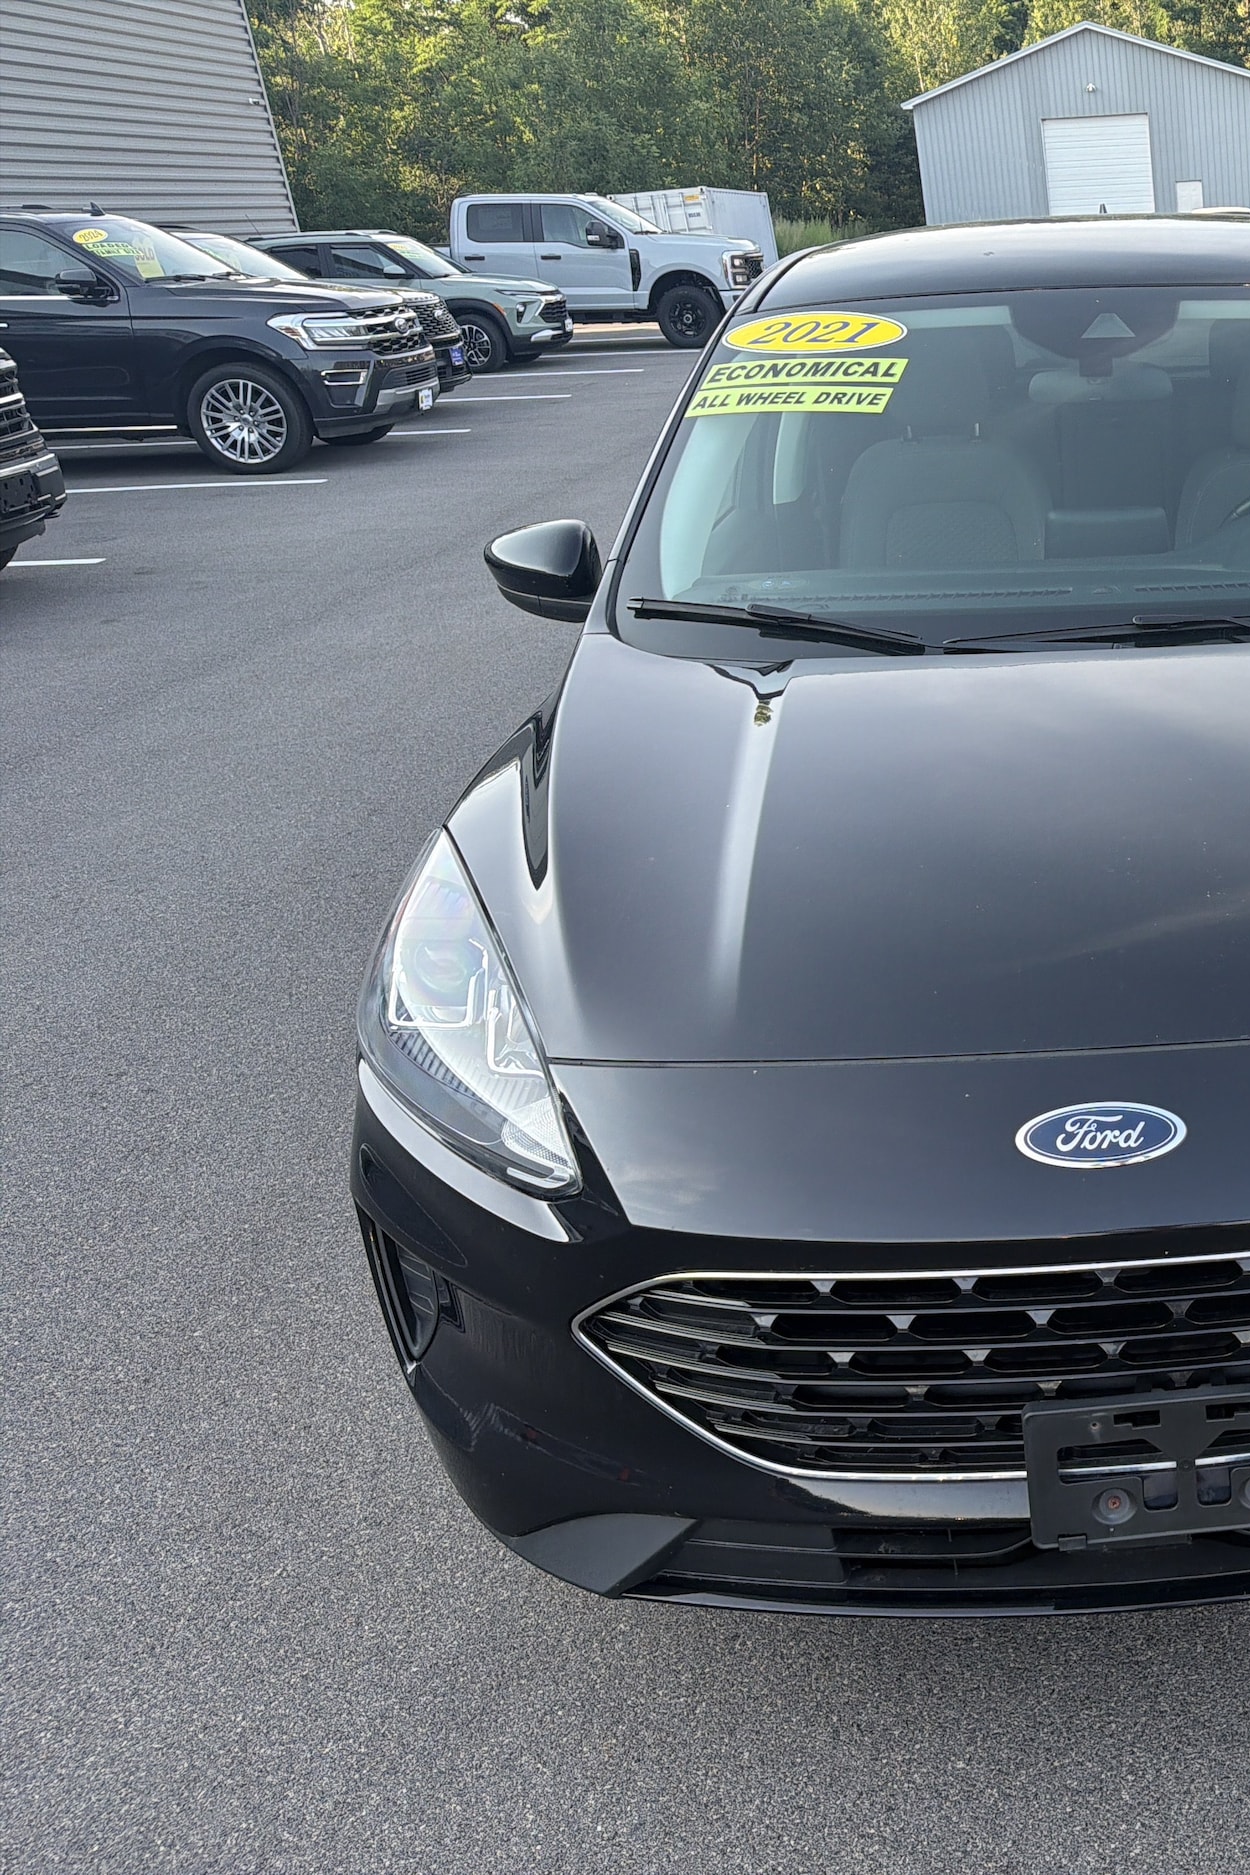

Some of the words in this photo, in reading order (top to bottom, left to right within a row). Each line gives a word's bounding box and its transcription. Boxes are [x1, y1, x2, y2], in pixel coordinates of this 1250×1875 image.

[79, 229, 104, 242] 2024
[747, 320, 881, 345] 2021
[706, 360, 899, 385] ECONOMICAL
[692, 391, 730, 411] ALL
[735, 391, 807, 408] WHEEL
[811, 391, 887, 407] DRIVE
[1056, 1114, 1146, 1152] Ford
